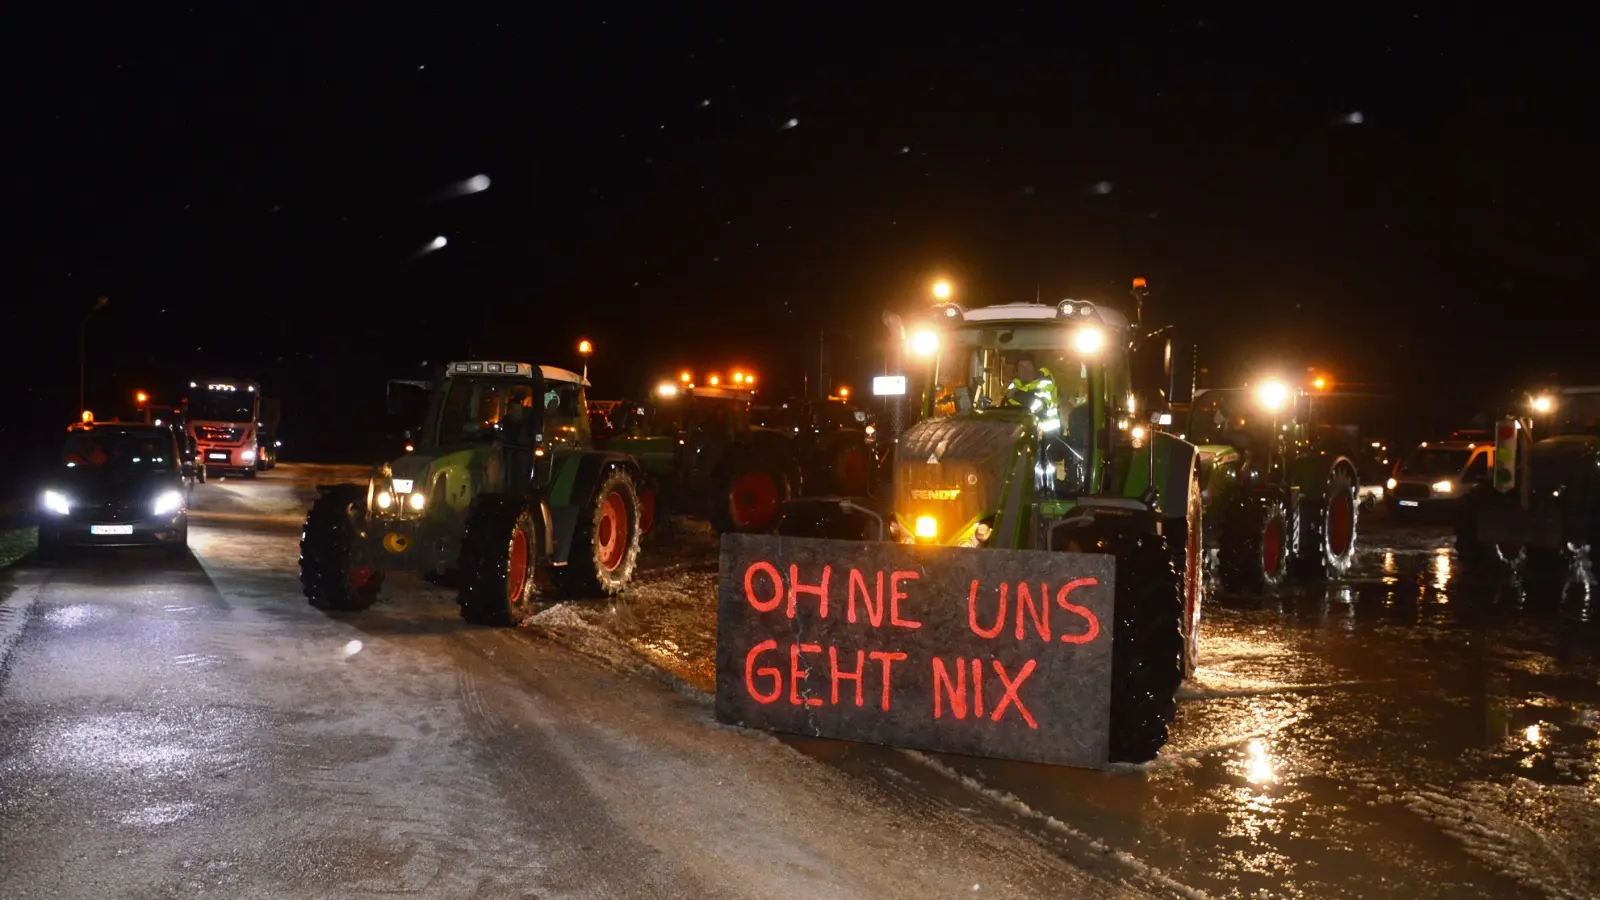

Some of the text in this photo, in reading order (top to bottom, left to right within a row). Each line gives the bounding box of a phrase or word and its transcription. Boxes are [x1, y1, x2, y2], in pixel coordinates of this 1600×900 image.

[910, 489, 961, 501] FENDT
[744, 561, 1100, 644] OHNE UNS
[745, 639, 1038, 729] GEHT NIX
